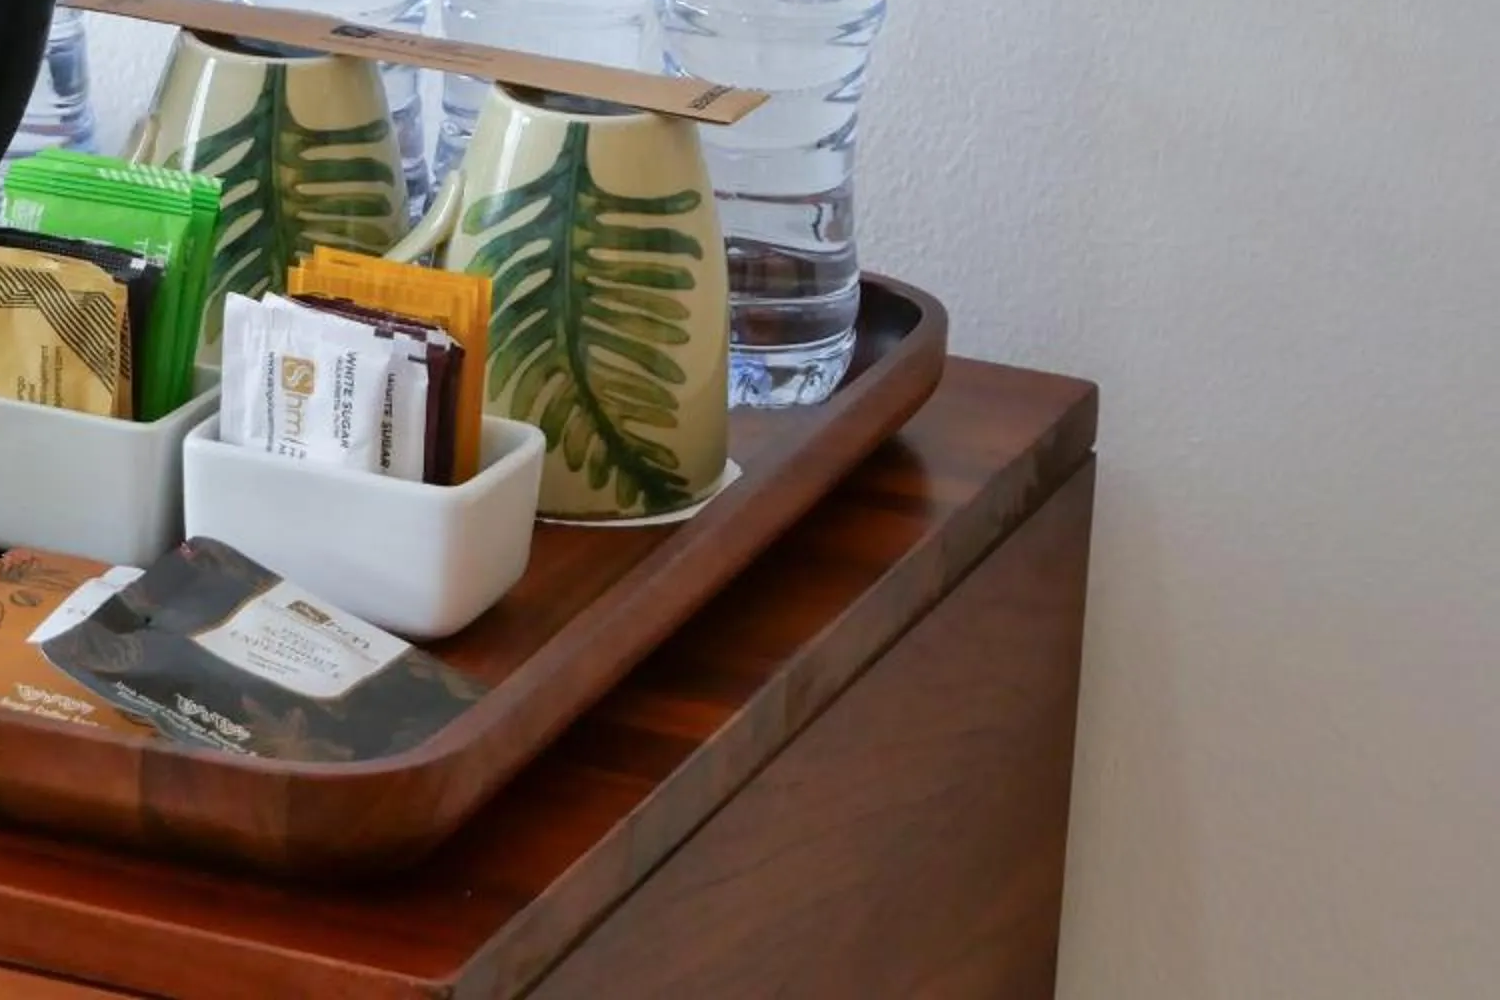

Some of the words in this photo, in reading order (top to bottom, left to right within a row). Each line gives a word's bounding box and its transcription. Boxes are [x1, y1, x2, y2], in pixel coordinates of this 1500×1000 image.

[343, 351, 357, 397] WHITE
[340, 401, 353, 449] SUGAR
[379, 420, 393, 469] SUGAR
